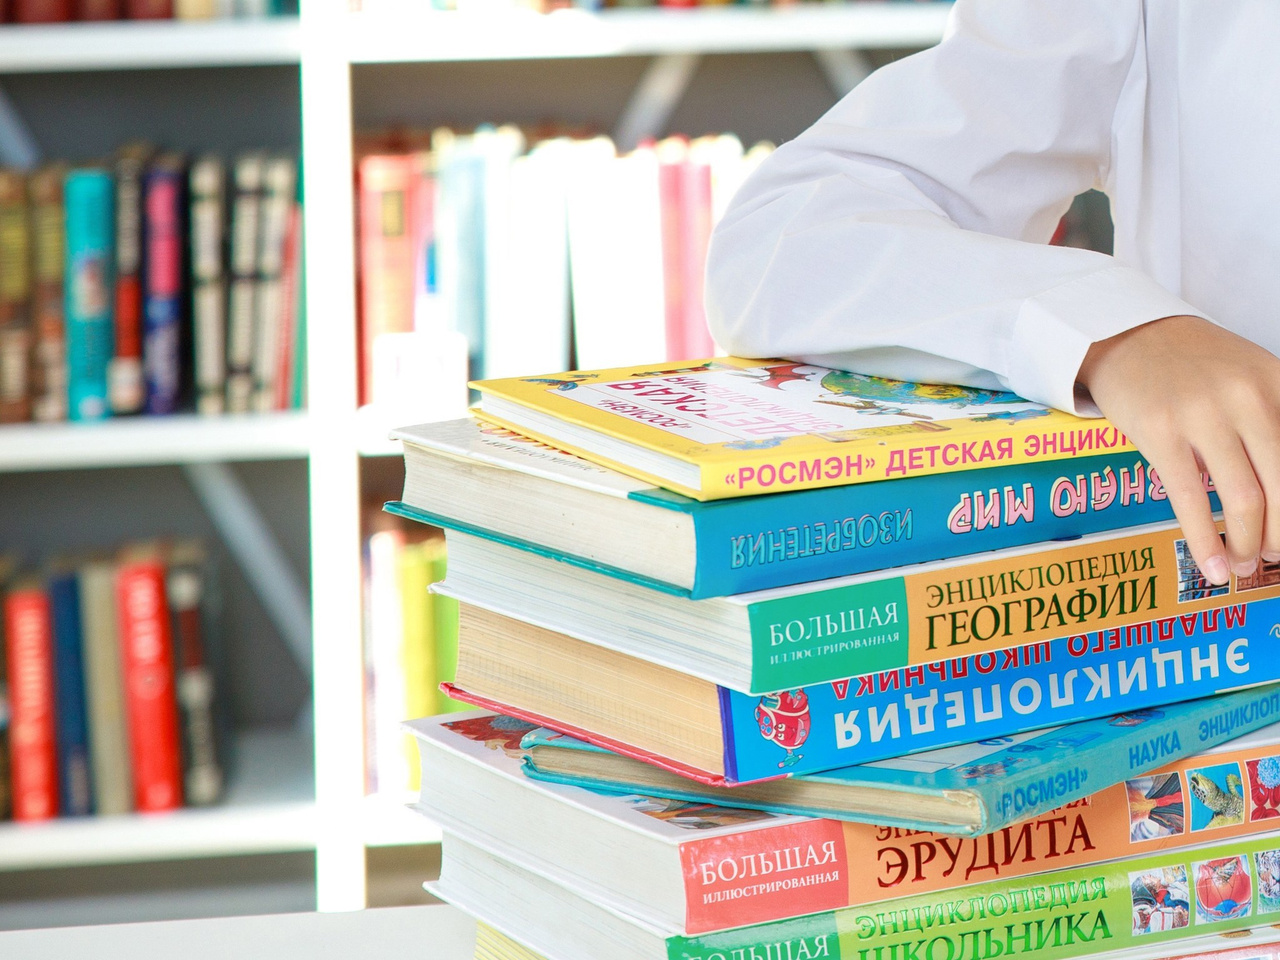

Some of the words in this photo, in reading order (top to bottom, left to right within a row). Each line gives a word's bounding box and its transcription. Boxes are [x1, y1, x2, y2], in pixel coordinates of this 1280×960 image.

[607, 381, 812, 435] ДЕТСКАЯ
[725, 454, 876, 489] «РОСМЭН»
[885, 437, 1014, 477] ДЕТСКАЯ
[1024, 425, 1127, 459] ЭНЦИКЛ
[947, 483, 1034, 535] МИР
[731, 508, 913, 568] ИЗОБРЕТЕНИЯ
[926, 546, 1156, 609] ЭНЦИКЛОПЕДИЯ
[769, 601, 899, 647] БОЛЬШАЯ
[925, 575, 1158, 651] ГЕОГРАФИИ
[1067, 603, 1248, 657] МЛАДШЕГО
[770, 631, 899, 666] ИЛЛЮСТРИРОВАННАЯ
[834, 638, 1250, 750] ЭНЦИКЛОПЕДИЯ
[1128, 730, 1181, 769] НАУКА
[700, 841, 837, 886] БОЛЬШАЯ
[876, 813, 1096, 888] ЭРУДИТА
[703, 870, 840, 905] ИЛЛЮСТРИРОВАННАЯ
[855, 876, 1109, 940] ЭНЦИКЛОПЕДИЯ
